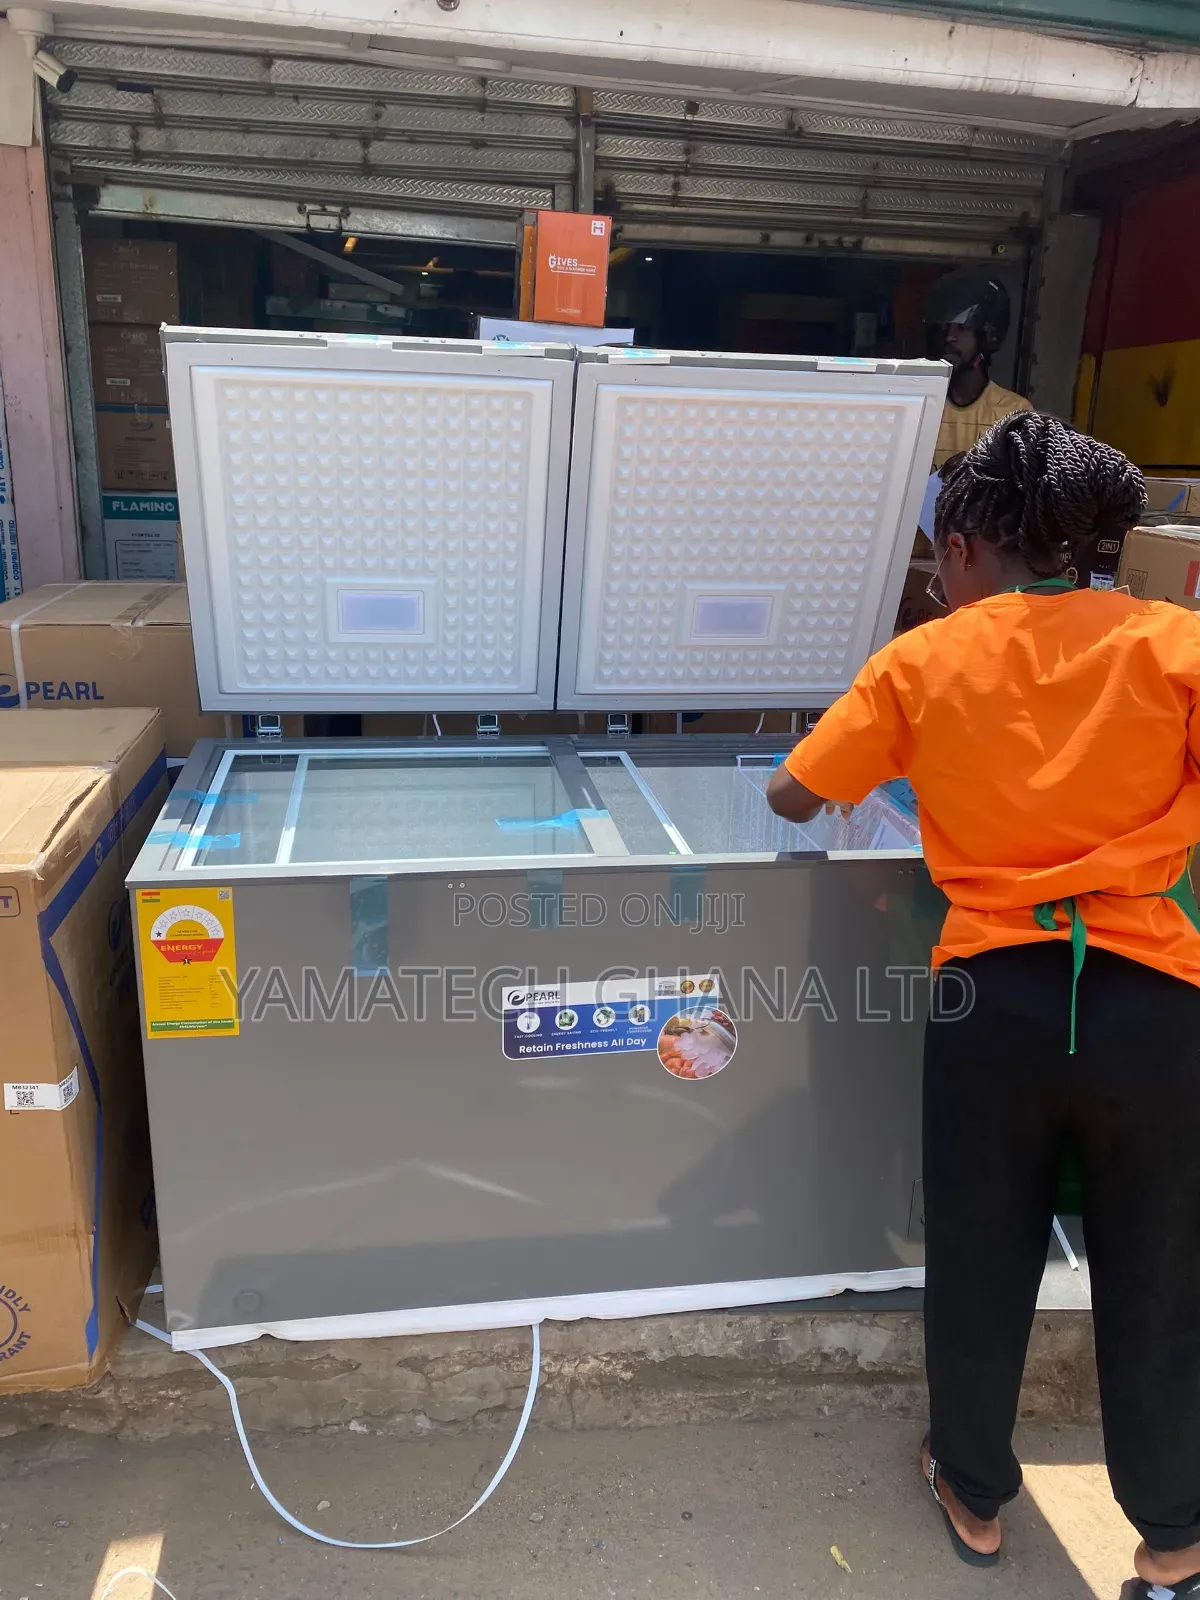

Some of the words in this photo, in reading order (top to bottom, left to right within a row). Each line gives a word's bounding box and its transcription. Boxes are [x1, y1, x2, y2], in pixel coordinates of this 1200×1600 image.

[548, 254, 578, 268] GIVES
[1101, 542, 1117, 551] 2IN1
[26, 681, 105, 700] PEARL
[160, 944, 203, 953] ENERGY
[526, 991, 561, 1001] PEARL
[519, 1044, 553, 1054] Retain
[555, 1040, 609, 1051] Freshness
[611, 1038, 624, 1047] All
[626, 1037, 647, 1049] Day
